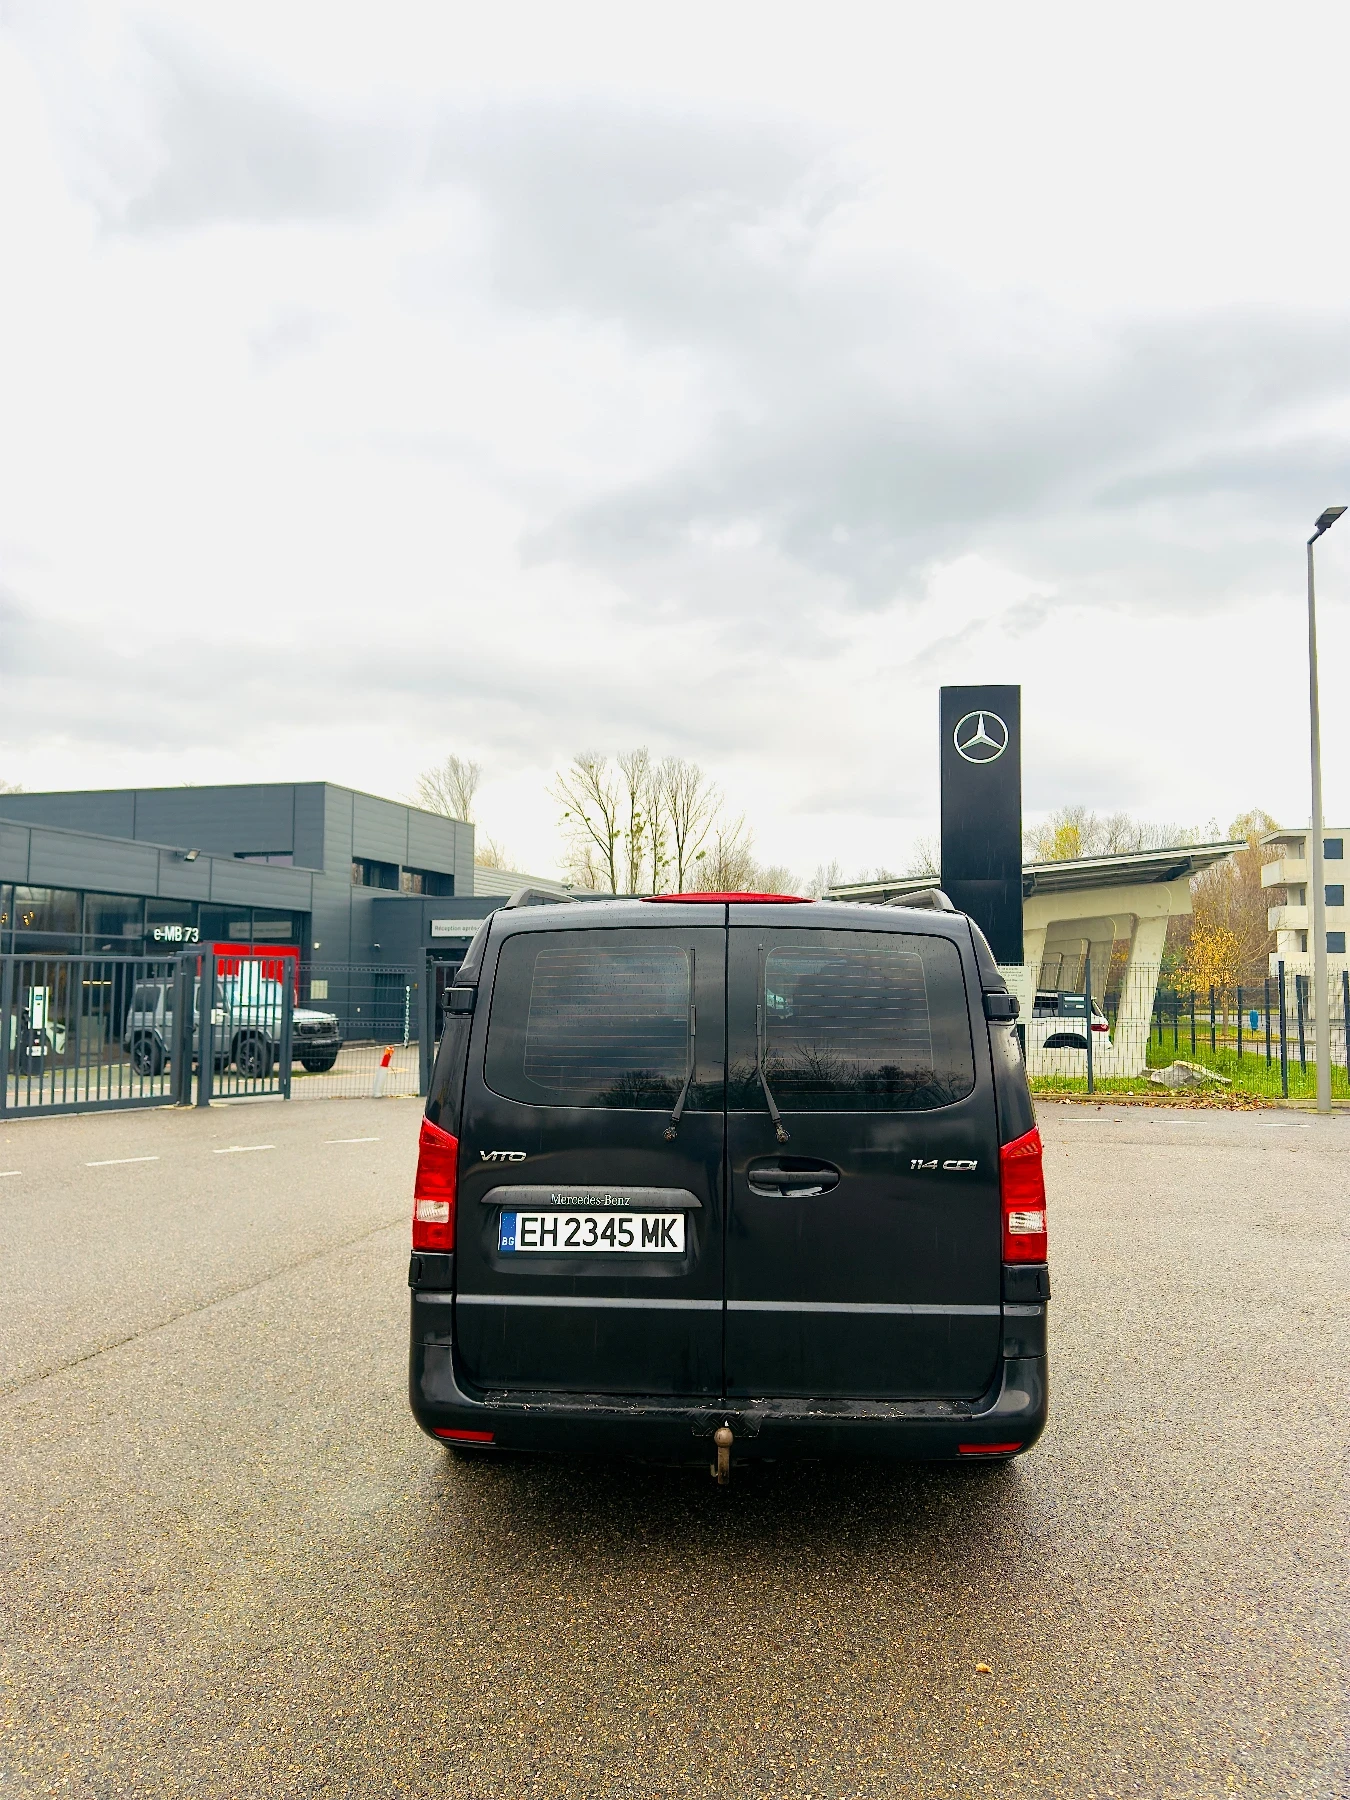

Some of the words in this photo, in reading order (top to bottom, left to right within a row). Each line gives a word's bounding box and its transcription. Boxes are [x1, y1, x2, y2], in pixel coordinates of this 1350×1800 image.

[153, 925, 183, 942] e-MB
[183, 926, 200, 943] 73
[479, 1150, 527, 1162] VITO
[910, 1159, 939, 1170] 114
[942, 1160, 978, 1171] CDI
[550, 1193, 631, 1207] Mercedes-Benz
[520, 1217, 558, 1247] EH
[564, 1217, 635, 1248] 2345
[641, 1218, 678, 1248] MK
[501, 1237, 515, 1246] BG
